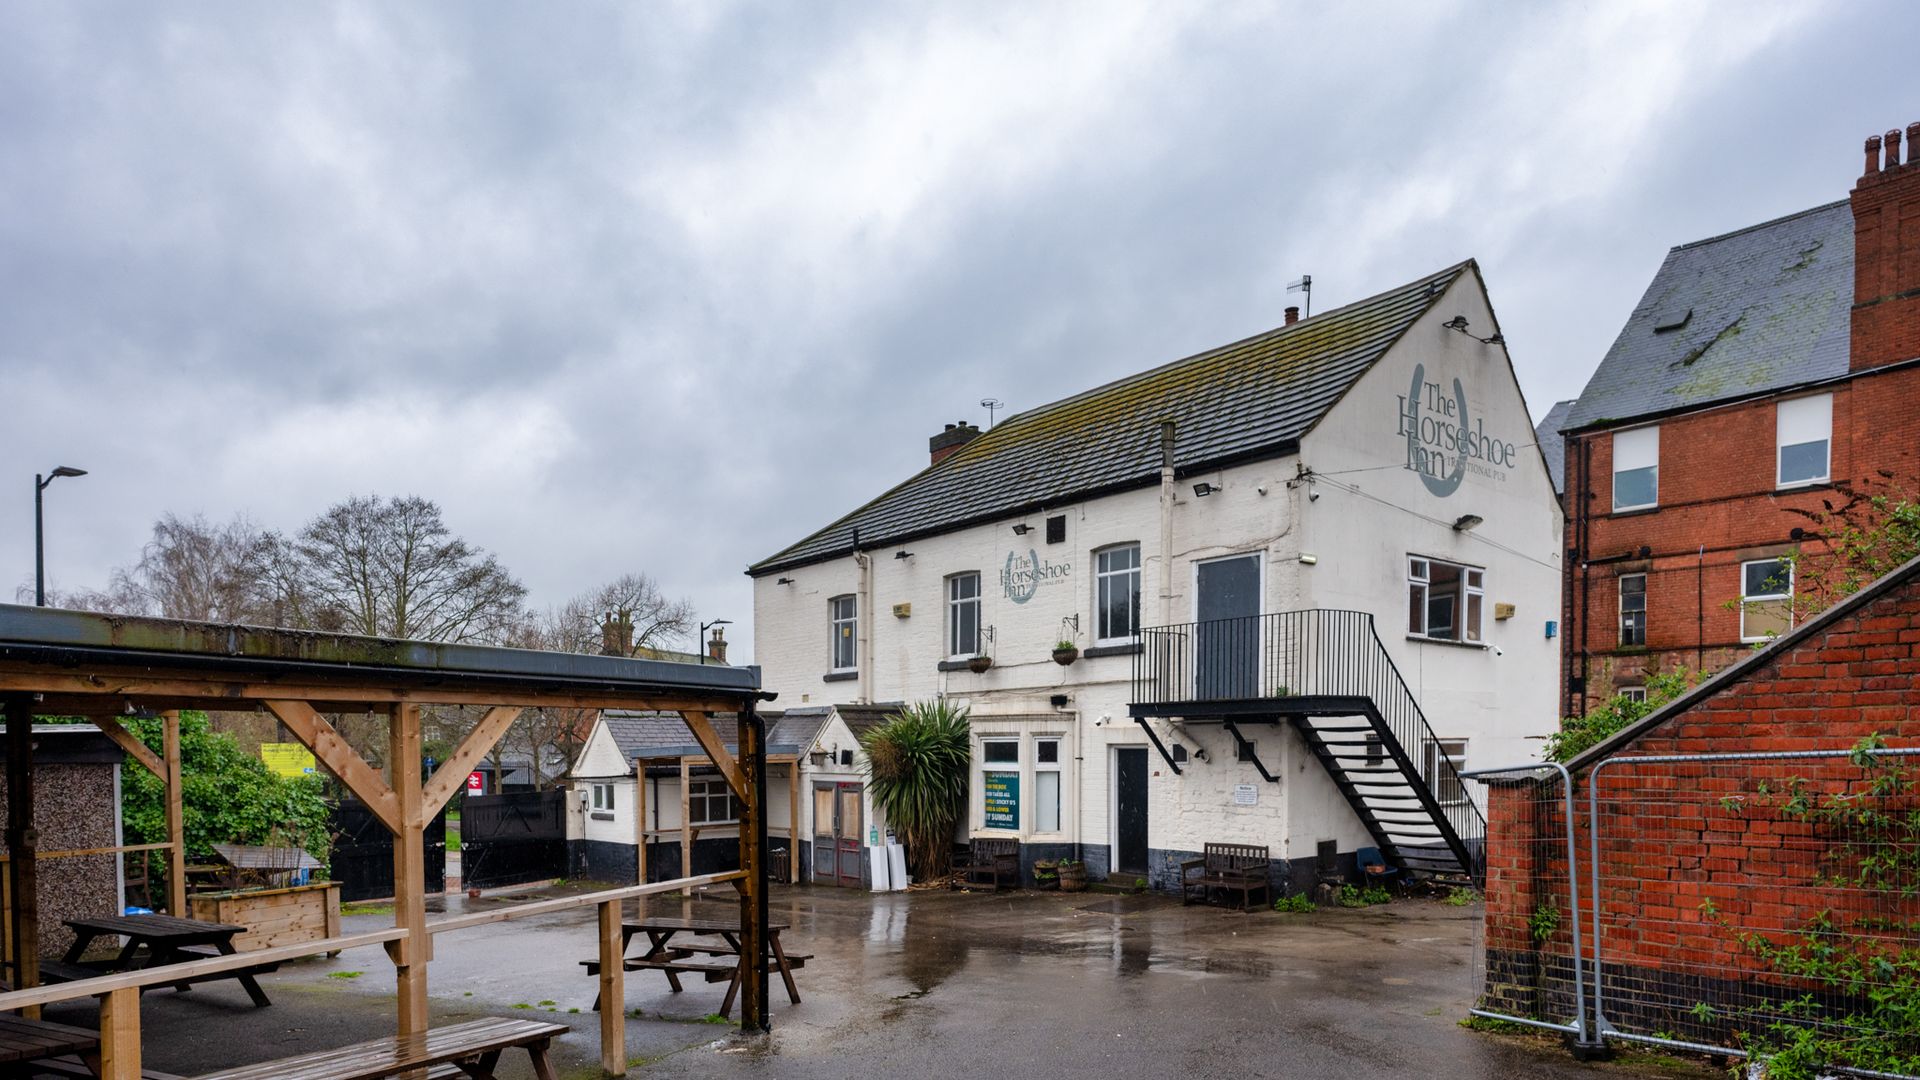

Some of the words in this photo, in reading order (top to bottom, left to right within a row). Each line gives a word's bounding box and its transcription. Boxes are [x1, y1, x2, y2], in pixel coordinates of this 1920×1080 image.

[1424, 382, 1456, 418] The
[1396, 394, 1515, 469] Horseshoe
[1403, 429, 1447, 480] Inn
[1447, 456, 1492, 478] TRATIONAL
[1494, 470, 1506, 482] PUB
[999, 560, 1071, 586] Horseshoe
[1014, 556, 1031, 569] The
[1003, 582, 1026, 598] Inn
